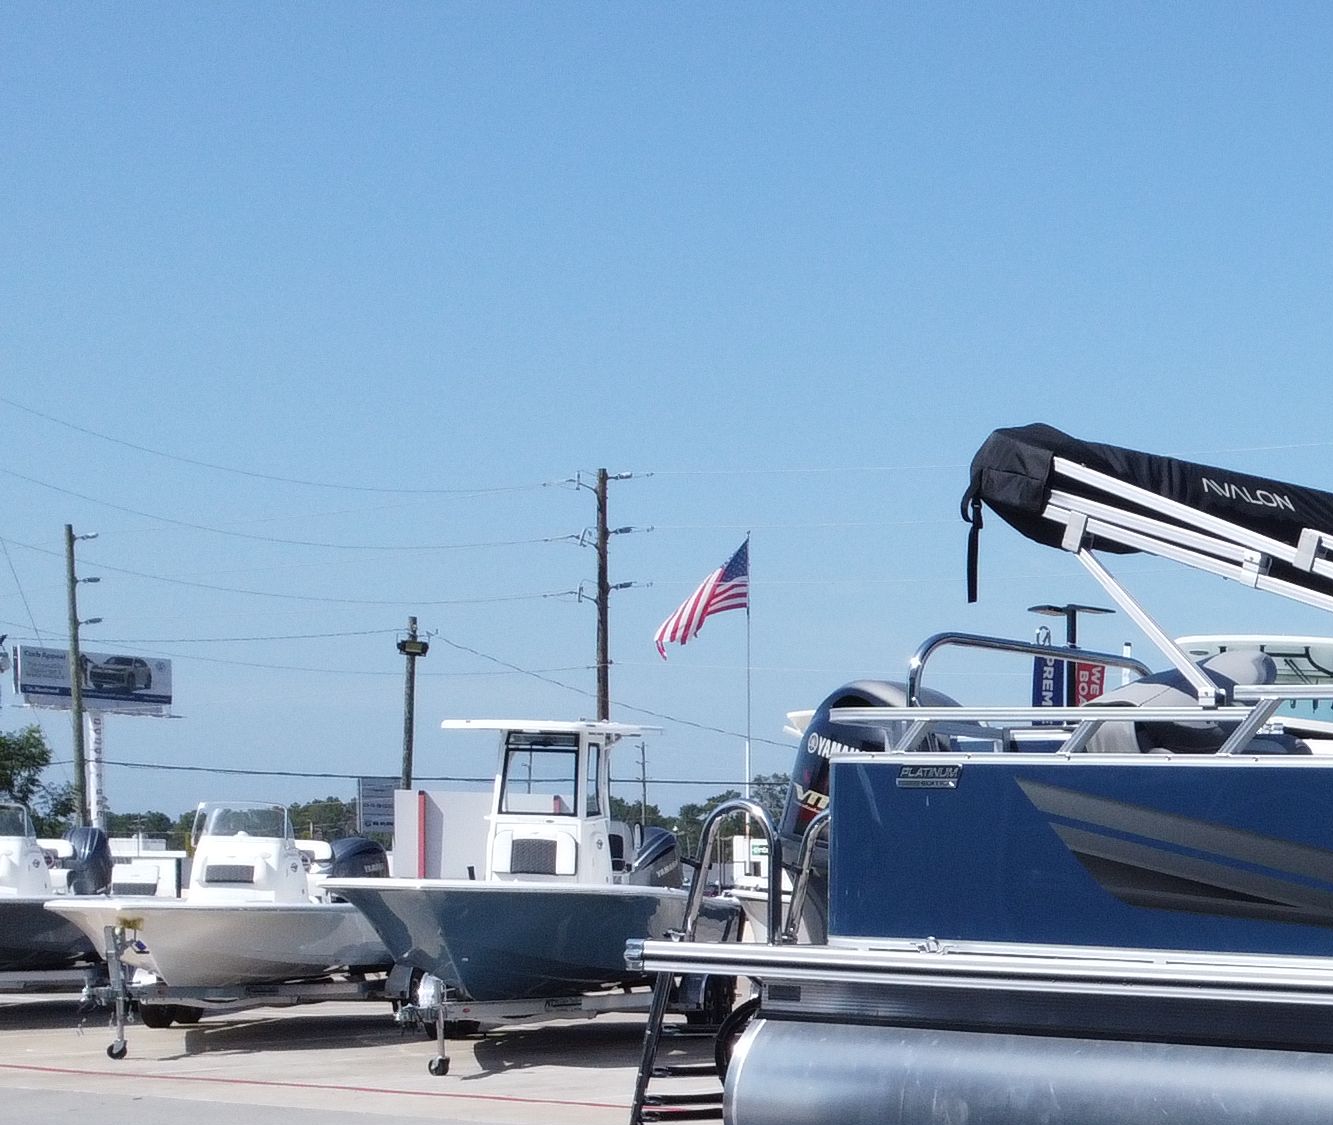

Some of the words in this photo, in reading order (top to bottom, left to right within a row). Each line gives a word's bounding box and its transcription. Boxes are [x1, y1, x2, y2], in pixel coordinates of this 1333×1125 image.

[1202, 477, 1296, 512] AVALON
[1041, 656, 1055, 725] PREM
[1090, 667, 1102, 695] WE
[817, 735, 866, 759] YAMA
[900, 767, 960, 778] PLATINUM
